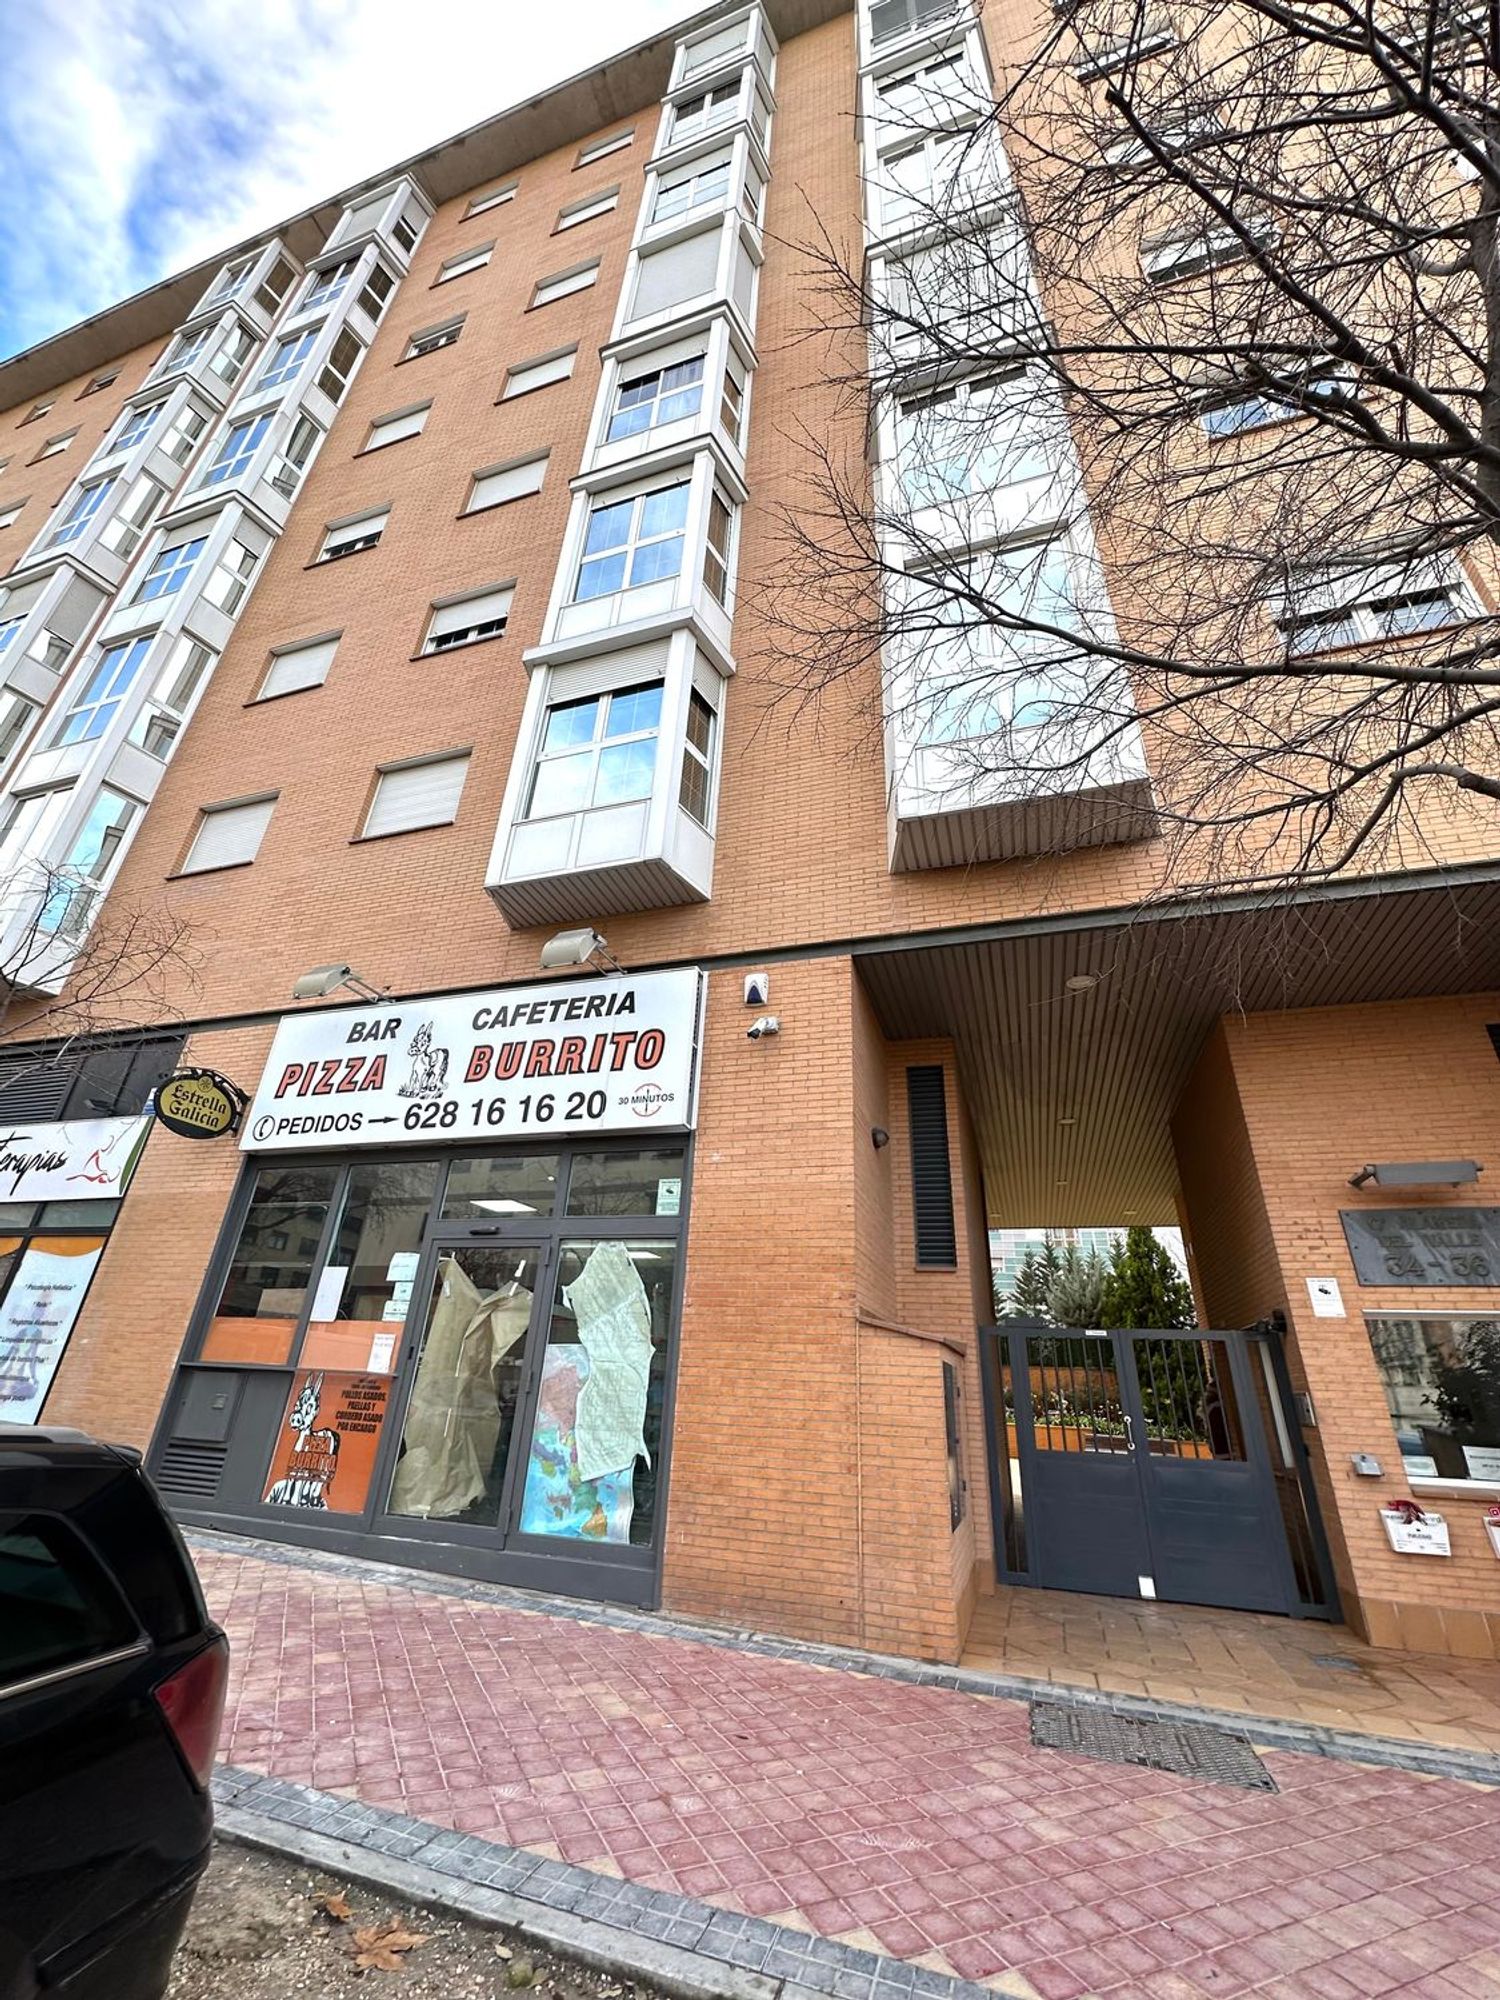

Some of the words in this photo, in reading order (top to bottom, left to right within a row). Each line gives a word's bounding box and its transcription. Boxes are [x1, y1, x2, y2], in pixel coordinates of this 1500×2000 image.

[346, 1018, 402, 1043] BAR
[472, 991, 636, 1031] CAFETERIA
[274, 1054, 388, 1099] PIZZA
[463, 1028, 666, 1083] BURRITO
[169, 1099, 220, 1129] Galicia
[171, 1084, 227, 1115] Estrella
[276, 1112, 364, 1136] PEDIDOS
[403, 1100, 459, 1131] 628
[471, 1097, 506, 1126] 16
[518, 1093, 555, 1123] 16
[564, 1089, 607, 1120] 20
[618, 1097, 630, 1106] 30
[631, 1093, 675, 1105] MINUTOS
[1385, 1253, 1426, 1278] 34
[287, 1451, 337, 1471] BURRITO
